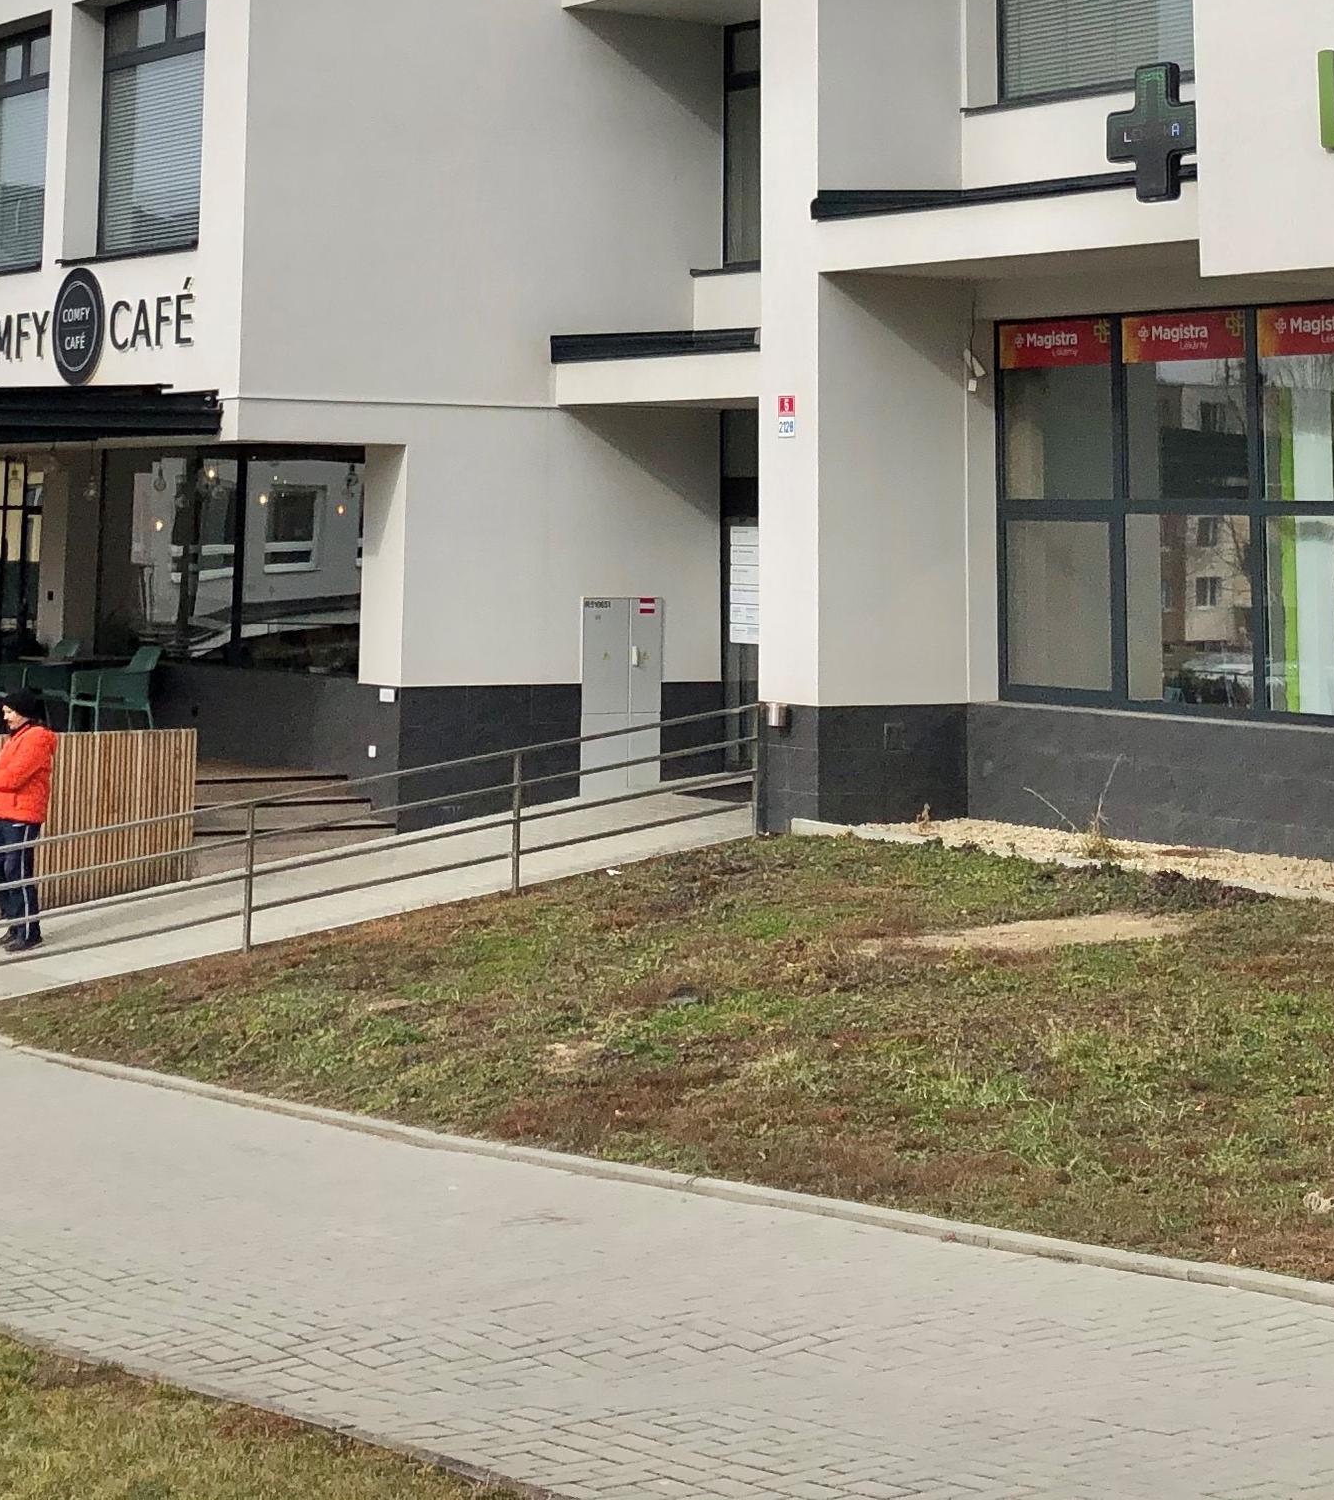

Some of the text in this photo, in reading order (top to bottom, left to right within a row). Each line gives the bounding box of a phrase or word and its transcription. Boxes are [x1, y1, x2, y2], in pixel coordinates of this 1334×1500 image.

[62, 306, 91, 324] COMFY
[109, 277, 194, 351] CAFÉ
[65, 332, 87, 350] CAFÉ
[1026, 330, 1078, 350] Magistra
[1151, 322, 1208, 344] Magistra
